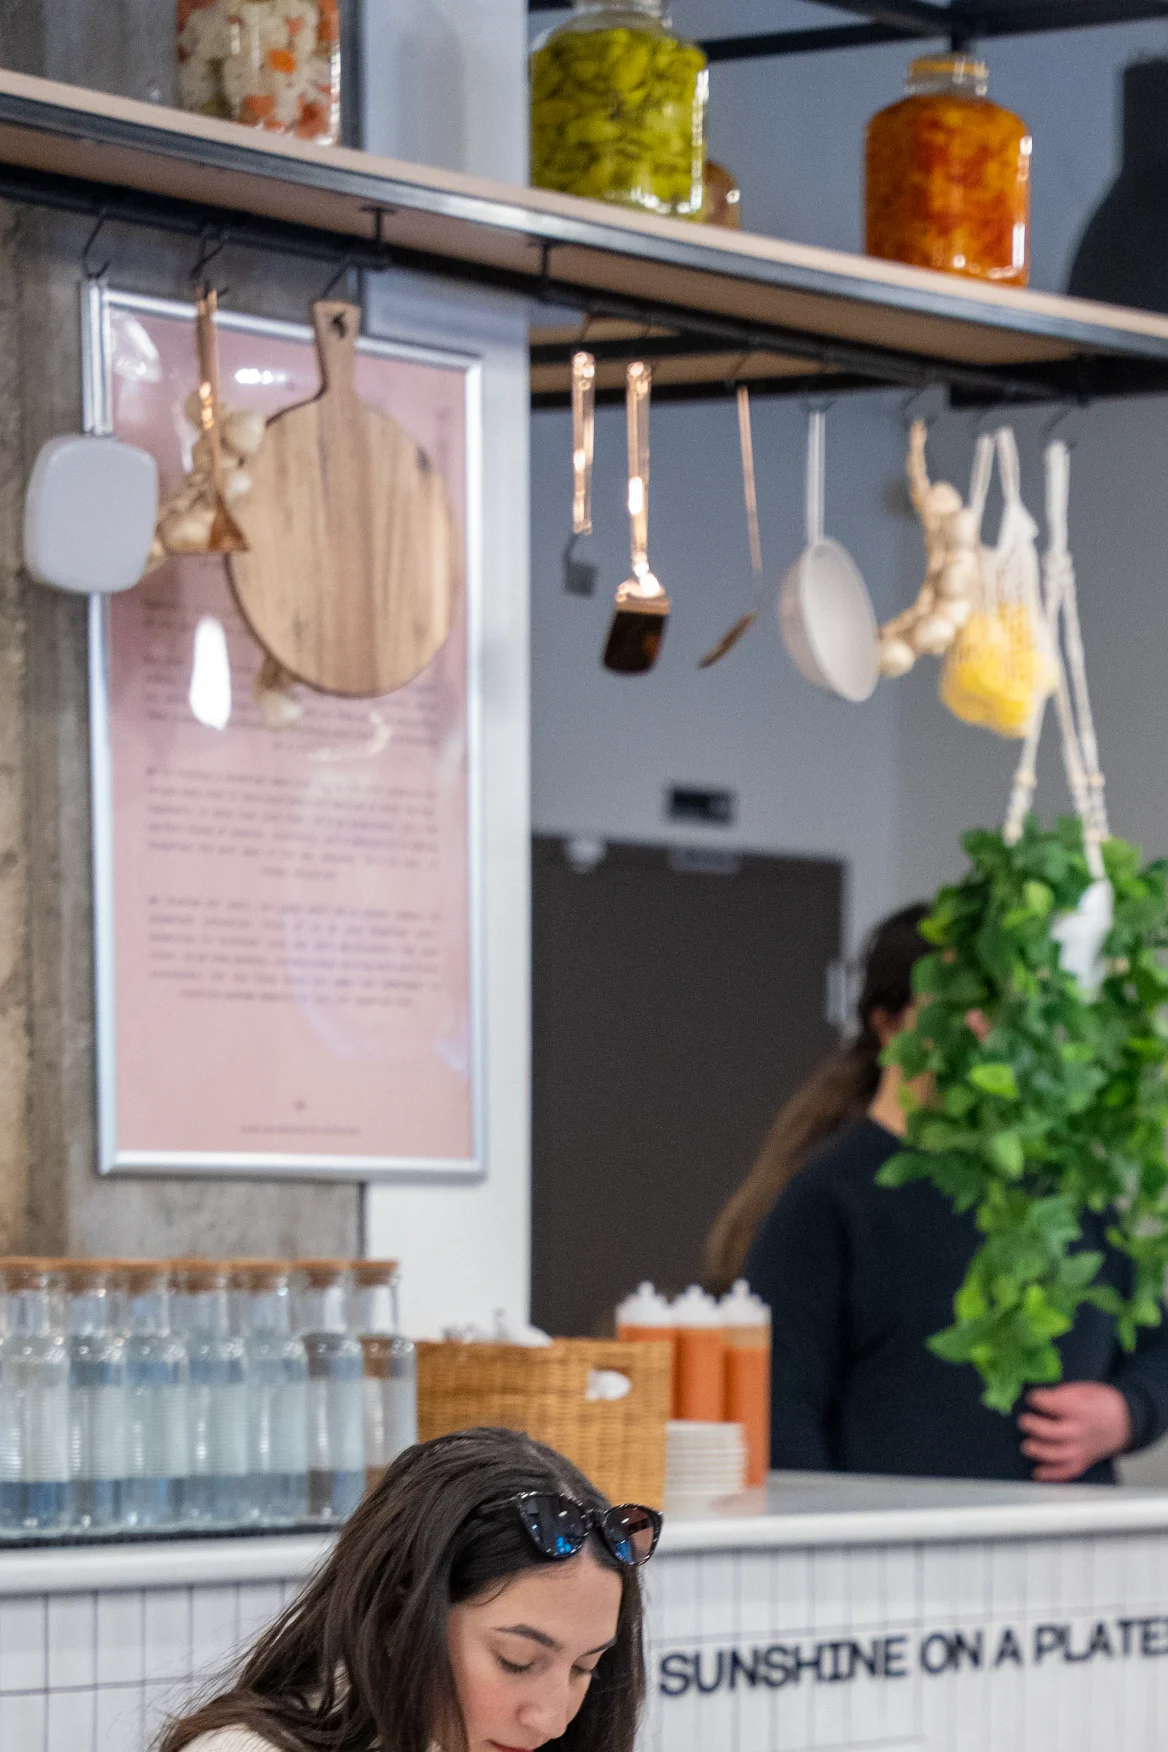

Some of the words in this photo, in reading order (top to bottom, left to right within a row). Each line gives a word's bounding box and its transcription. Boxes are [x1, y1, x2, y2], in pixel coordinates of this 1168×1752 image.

[658, 1634, 907, 1698] SUNSHINE
[920, 1630, 983, 1675] ON
[993, 1627, 1024, 1671] A
